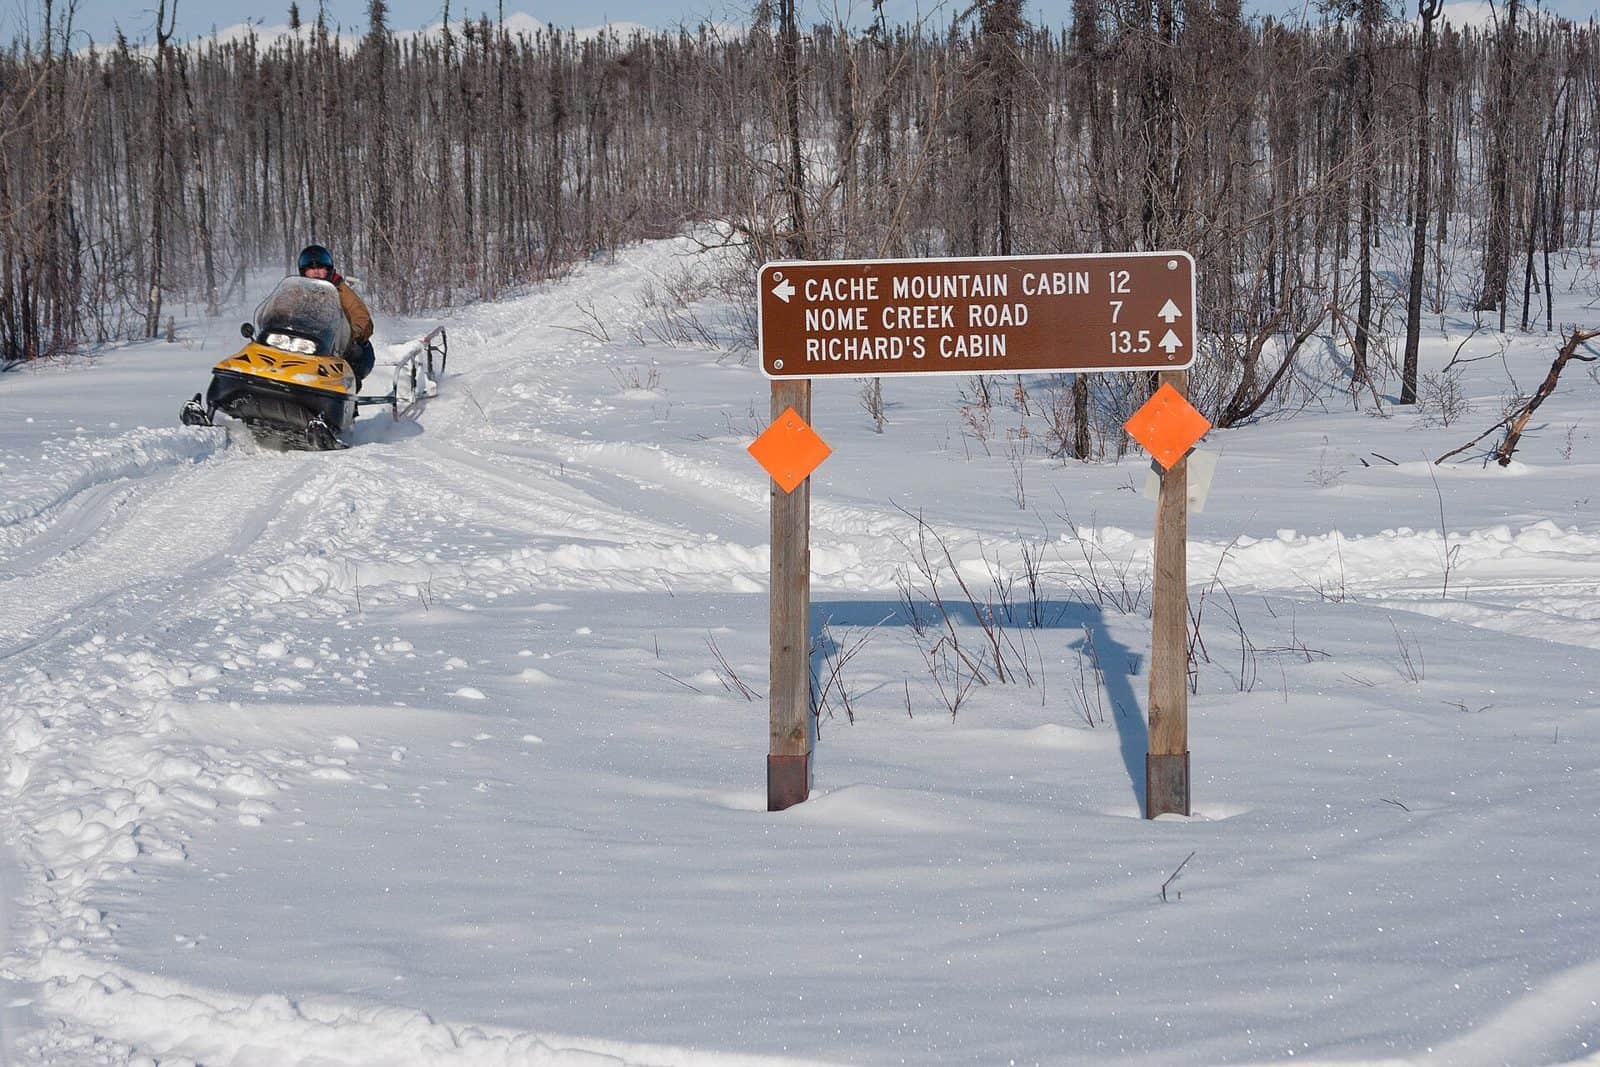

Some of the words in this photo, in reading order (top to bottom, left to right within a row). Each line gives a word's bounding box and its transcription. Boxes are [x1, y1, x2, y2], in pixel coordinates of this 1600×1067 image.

[804, 277, 879, 302] CACHE
[893, 273, 1008, 299] MOUNTAIN
[1022, 271, 1090, 296] CABIN
[1108, 271, 1131, 294] 12
[805, 307, 869, 332] NOME
[882, 304, 955, 330] CREEK
[968, 303, 1029, 328] ROAD
[1109, 300, 1124, 324] 7
[806, 336, 926, 362] RICHARD'S
[939, 333, 1007, 359] CABIN
[1110, 330, 1151, 354] 13.5
